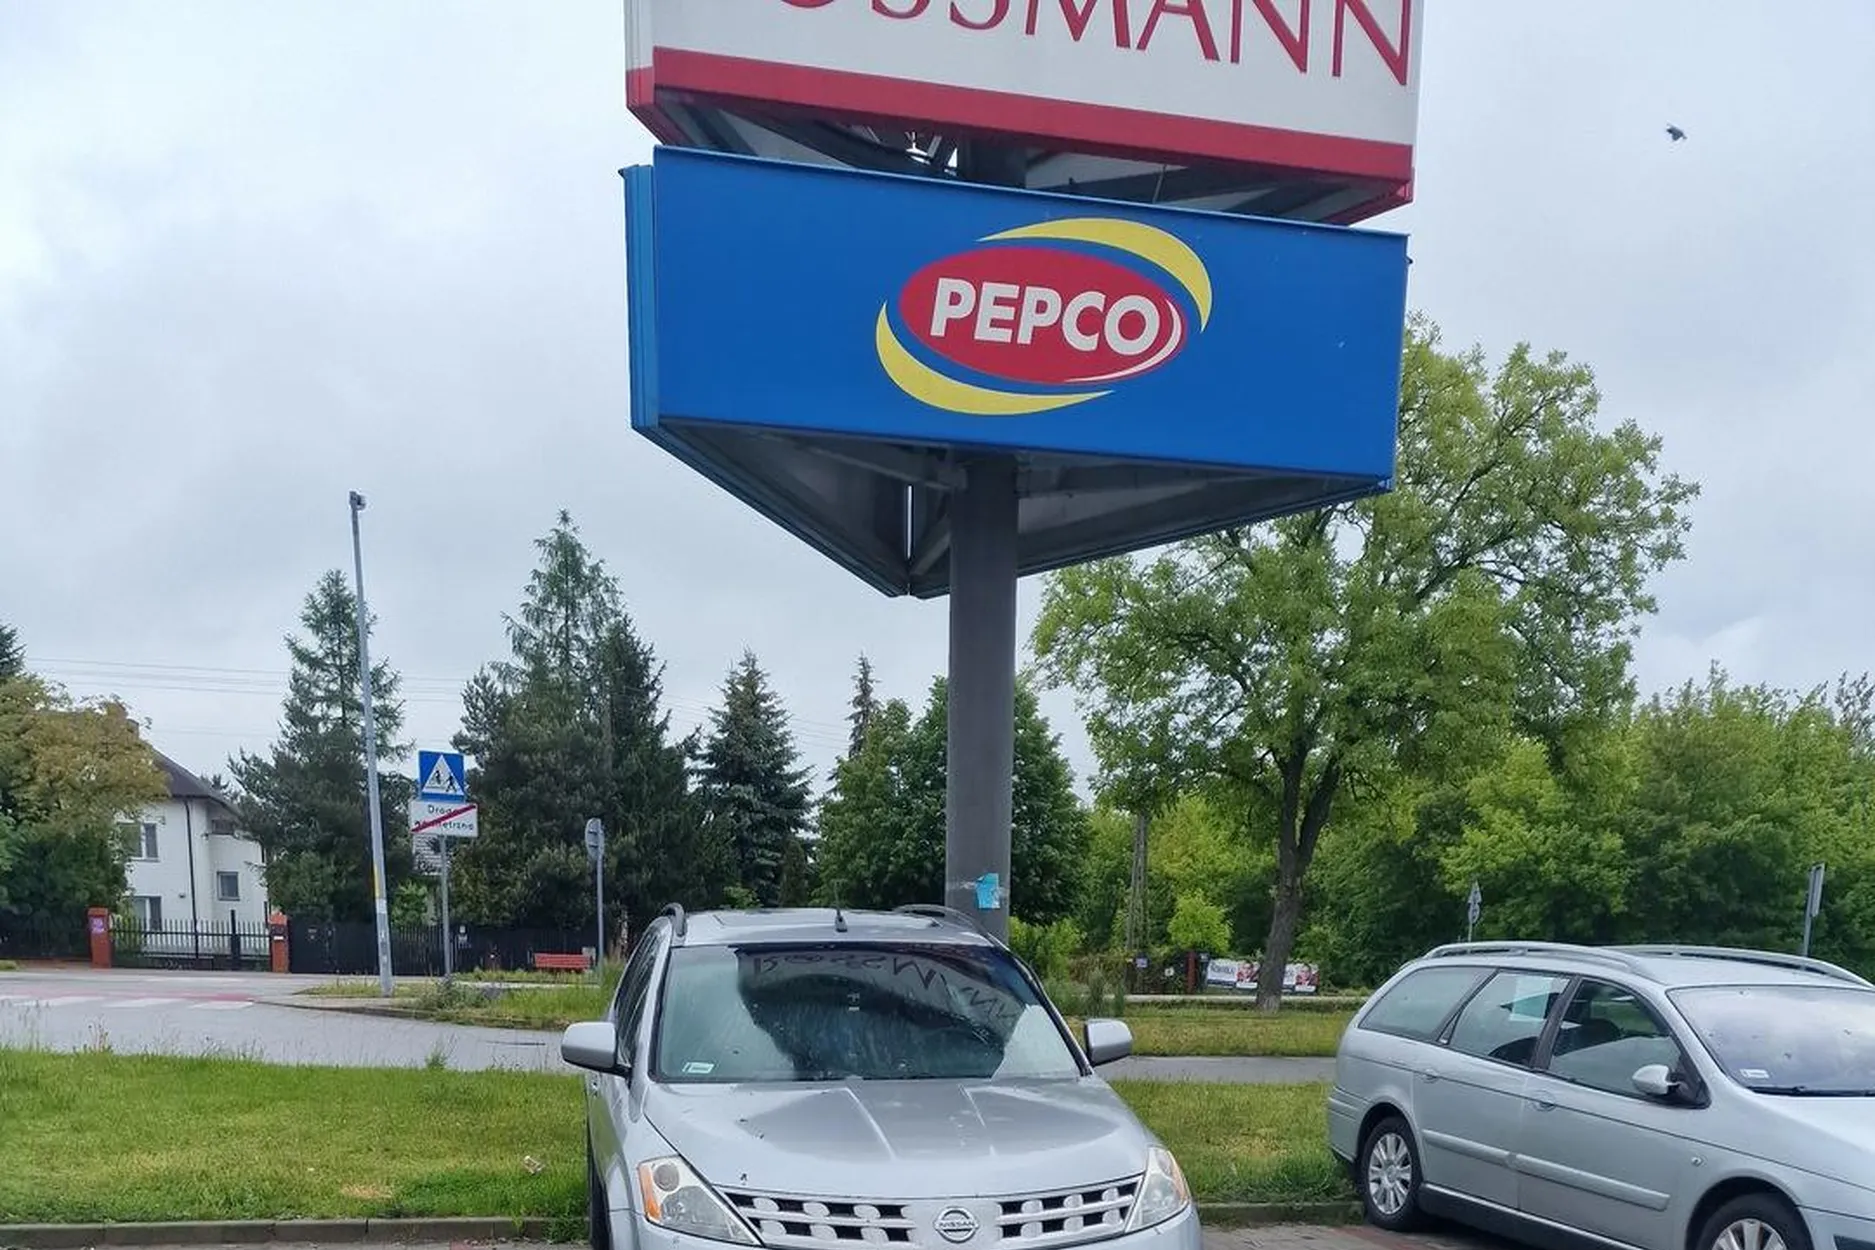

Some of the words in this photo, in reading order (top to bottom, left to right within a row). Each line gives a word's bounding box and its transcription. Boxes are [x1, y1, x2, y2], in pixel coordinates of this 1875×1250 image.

[780, 0, 1412, 86] MANN
[930, 277, 1160, 356] PEPCO
[428, 804, 459, 818] Drog
